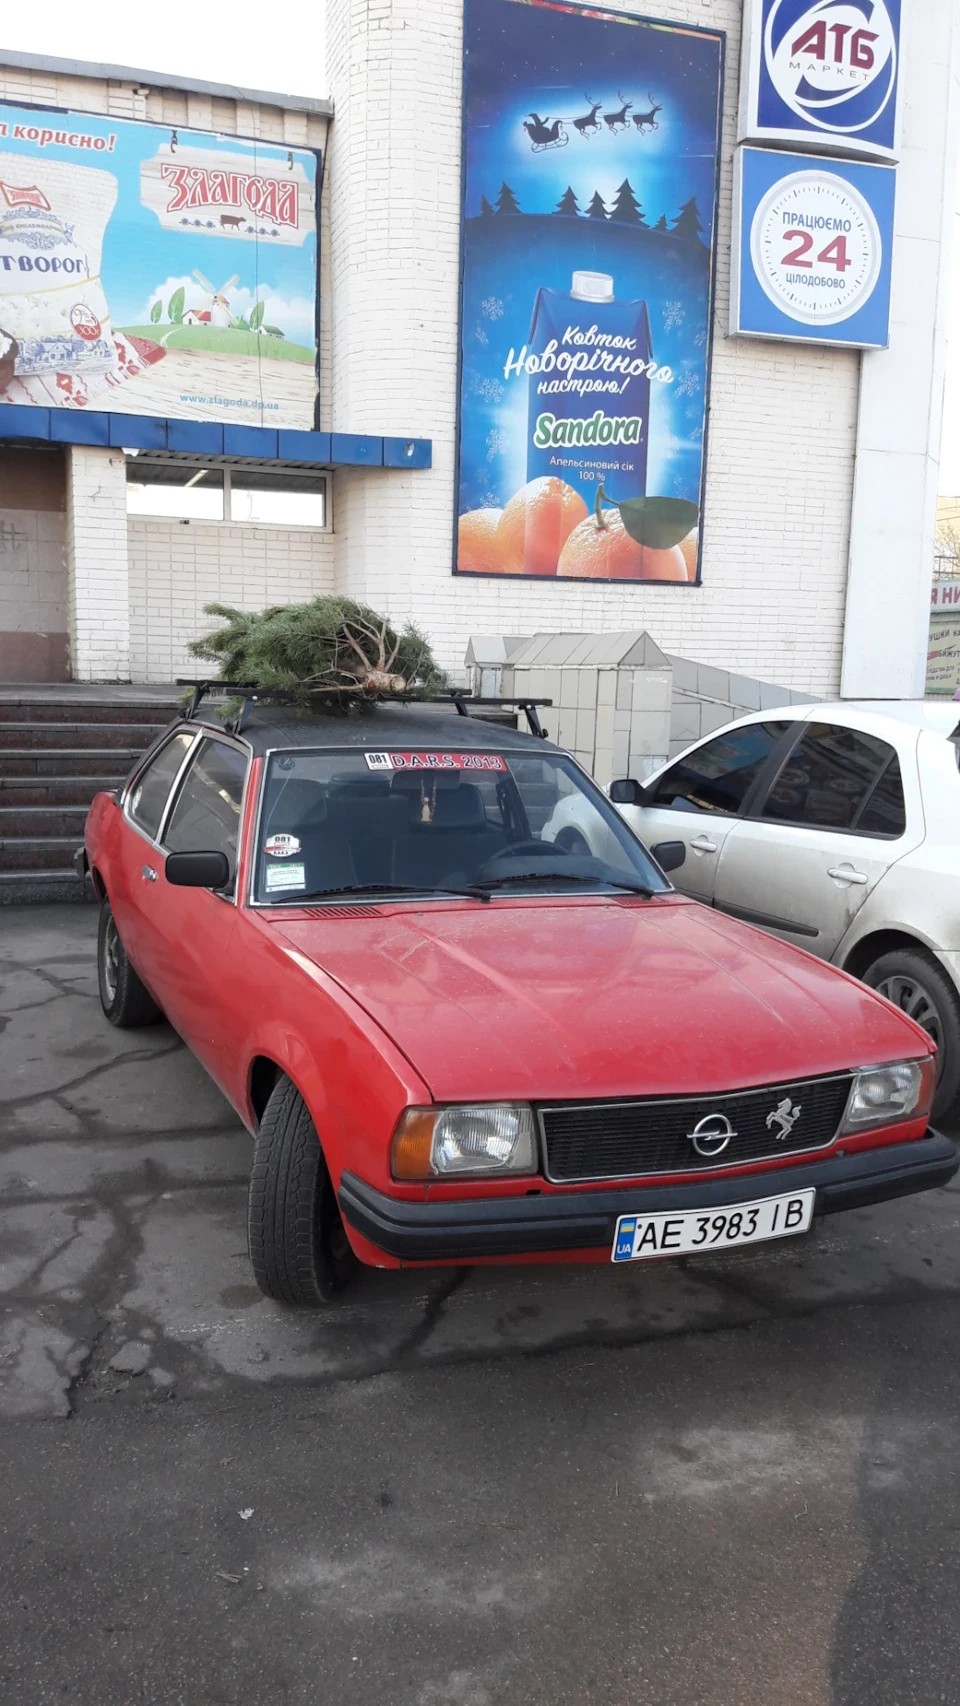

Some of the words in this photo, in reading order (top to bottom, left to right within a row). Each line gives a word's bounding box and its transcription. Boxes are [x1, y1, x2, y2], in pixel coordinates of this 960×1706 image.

[791, 20, 880, 70] АТБ
[789, 62, 869, 80] МАРКЕТ
[13, 125, 116, 152] корисно!
[160, 163, 299, 230] ЗЛАГОДА
[782, 211, 852, 232] ПРАЦЮЄМО
[780, 229, 852, 272] 24
[786, 273, 846, 289] ЦІЛОДОБОВО
[562, 325, 637, 350] Ковток
[503, 339, 674, 383] Новорічного
[537, 377, 631, 397] настрою!
[534, 411, 641, 448] Sandora
[550, 456, 620, 471] Апельсиновий
[621, 461, 635, 471] сік
[578, 471, 595, 481] 100
[368, 754, 387, 764] 081
[461, 755, 502, 769] 2013
[636, 1219, 685, 1252] AE
[691, 1208, 760, 1245] 3983
[771, 1199, 804, 1232] IB
[616, 1244, 631, 1254] UA
